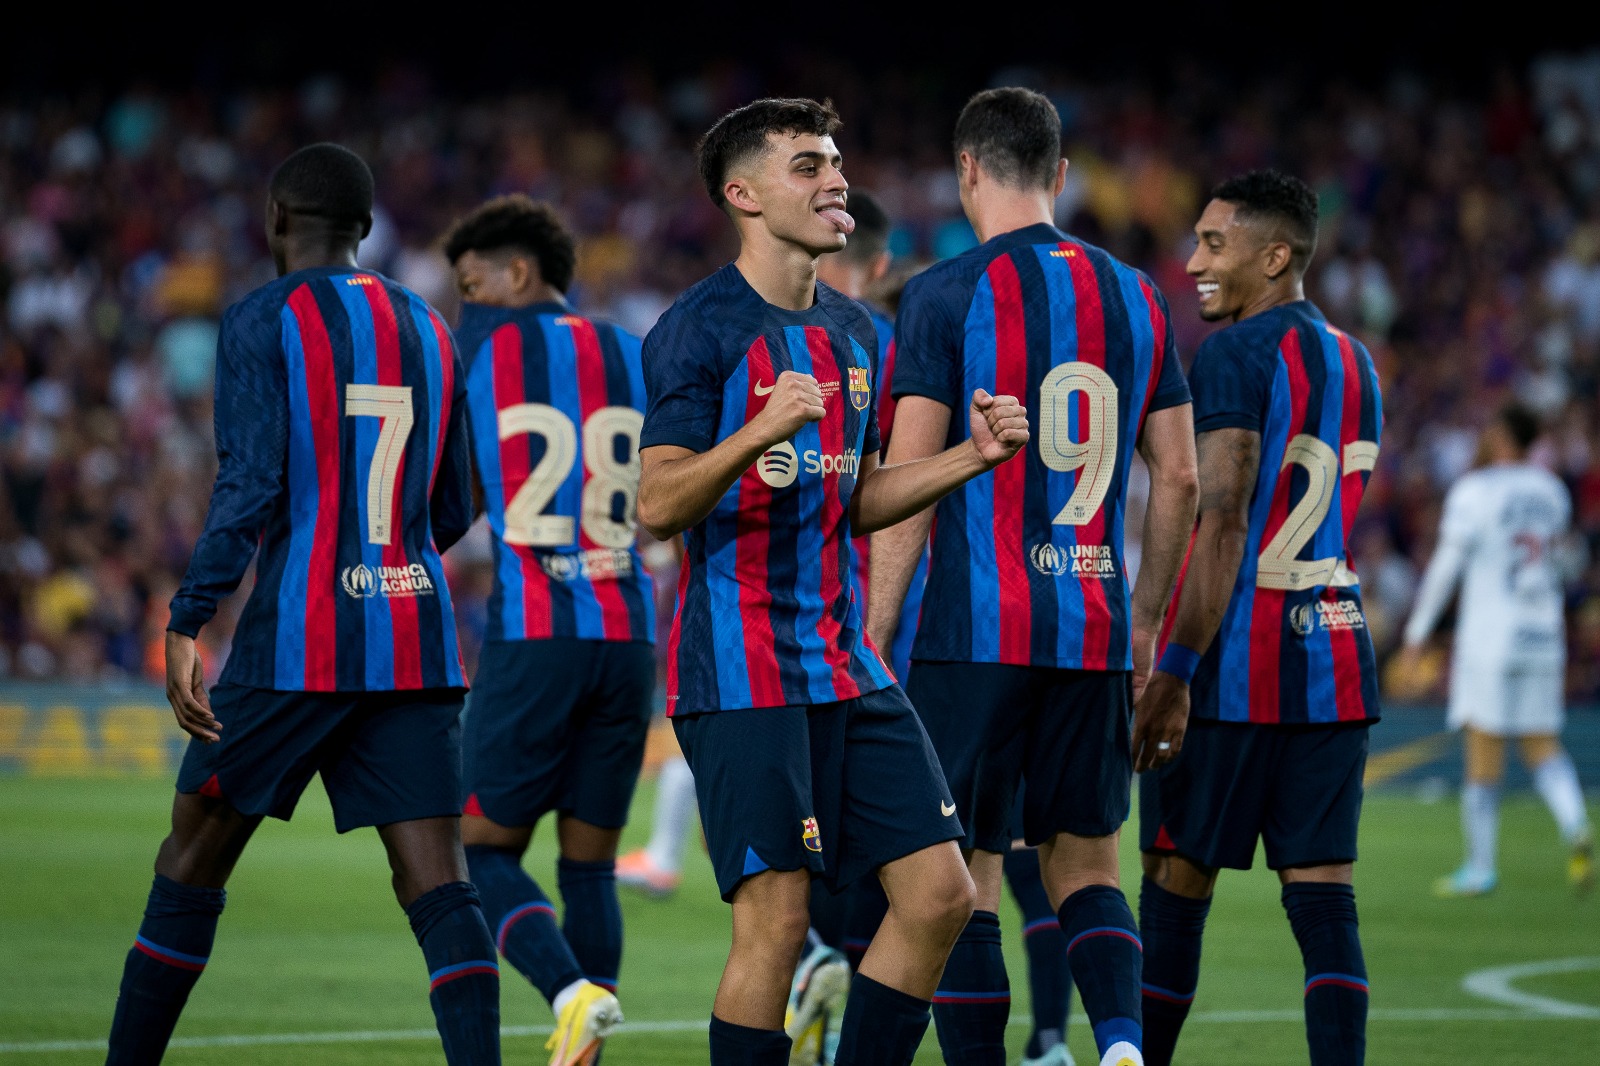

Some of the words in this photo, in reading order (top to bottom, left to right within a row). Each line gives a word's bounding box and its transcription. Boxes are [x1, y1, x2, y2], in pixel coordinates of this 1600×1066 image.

[1038, 361, 1119, 525] 9
[345, 383, 414, 545] 7
[498, 403, 644, 549] 28
[803, 447, 861, 480] Spotify
[1069, 544, 1112, 559] UNHCR
[1071, 559, 1115, 573] ACNUR
[380, 576, 433, 593] ACNUR
